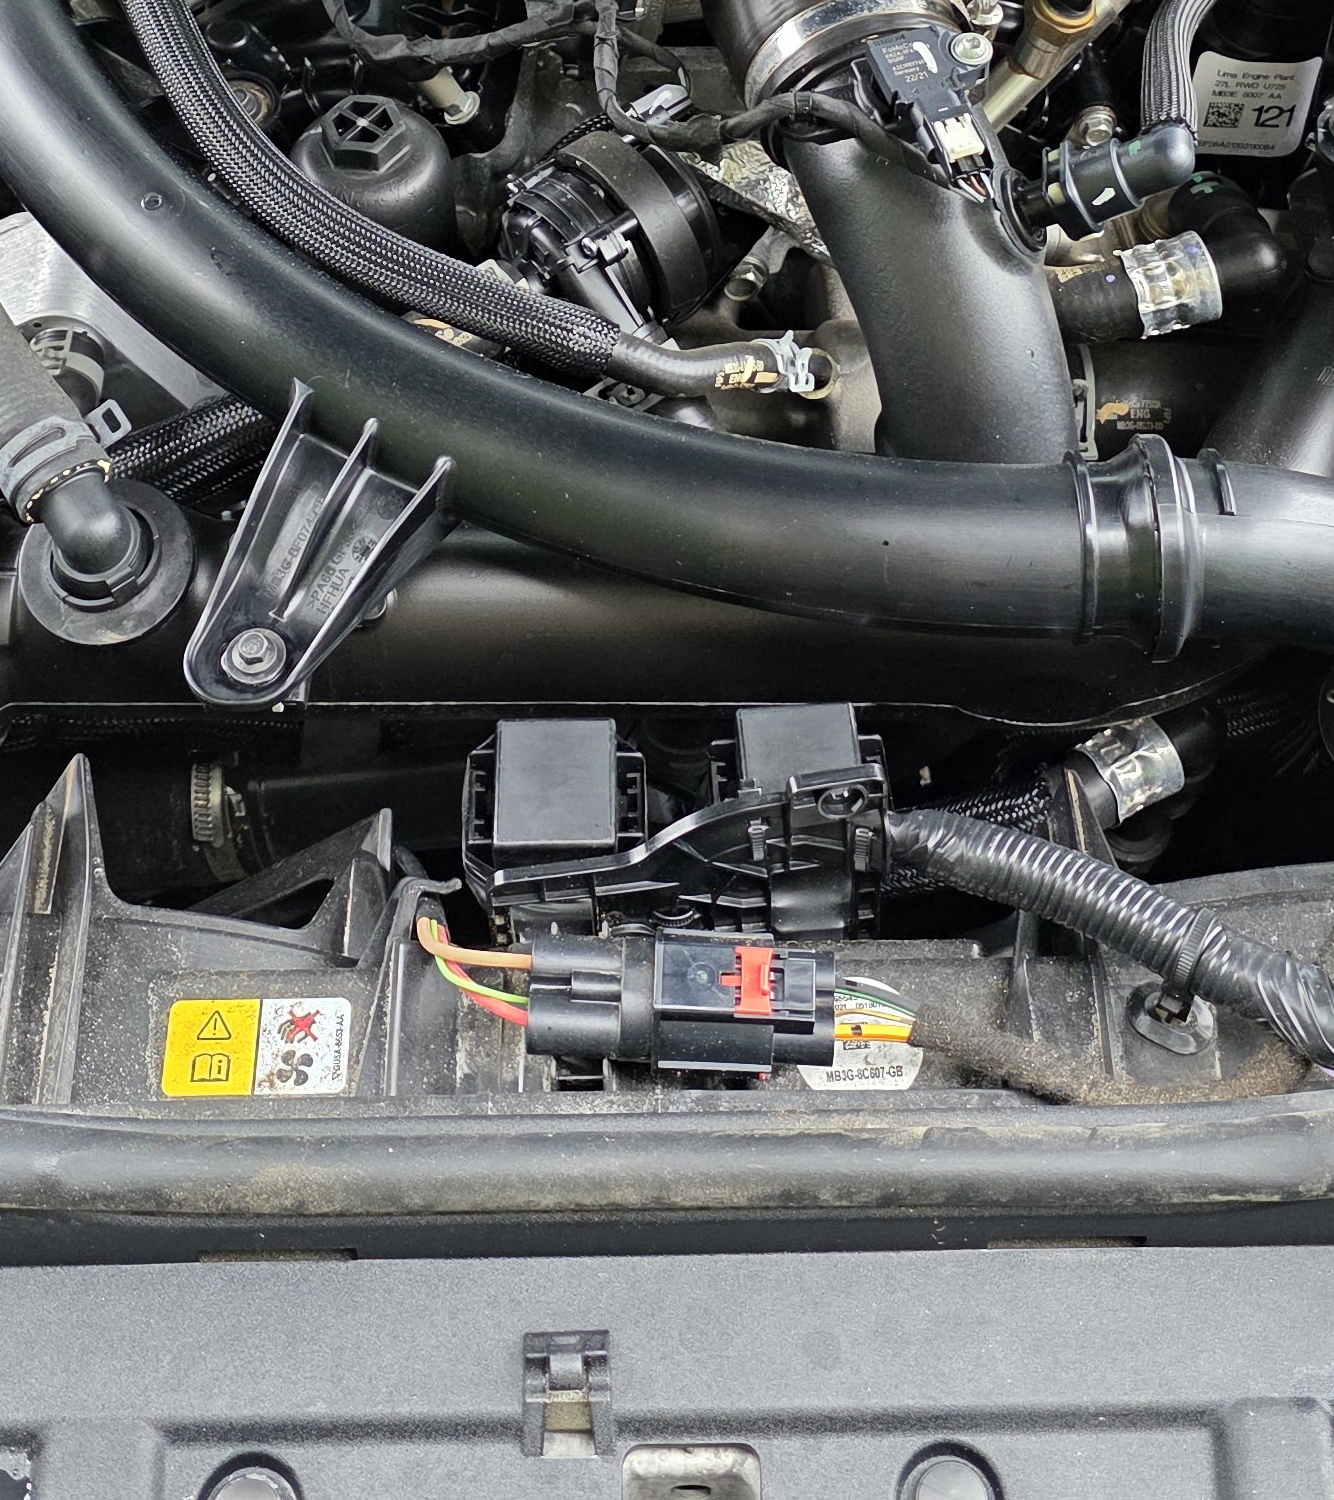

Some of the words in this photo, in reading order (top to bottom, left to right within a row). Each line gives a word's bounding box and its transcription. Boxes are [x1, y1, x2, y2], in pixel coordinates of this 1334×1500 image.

[905, 71, 929, 83] 22/21
[1217, 68, 1238, 79] Lima
[1241, 71, 1272, 81] Engine
[1235, 82, 1259, 90] RWD
[1267, 92, 1283, 100] AA
[1251, 103, 1297, 129] 121
[1130, 408, 1152, 420] ENG
